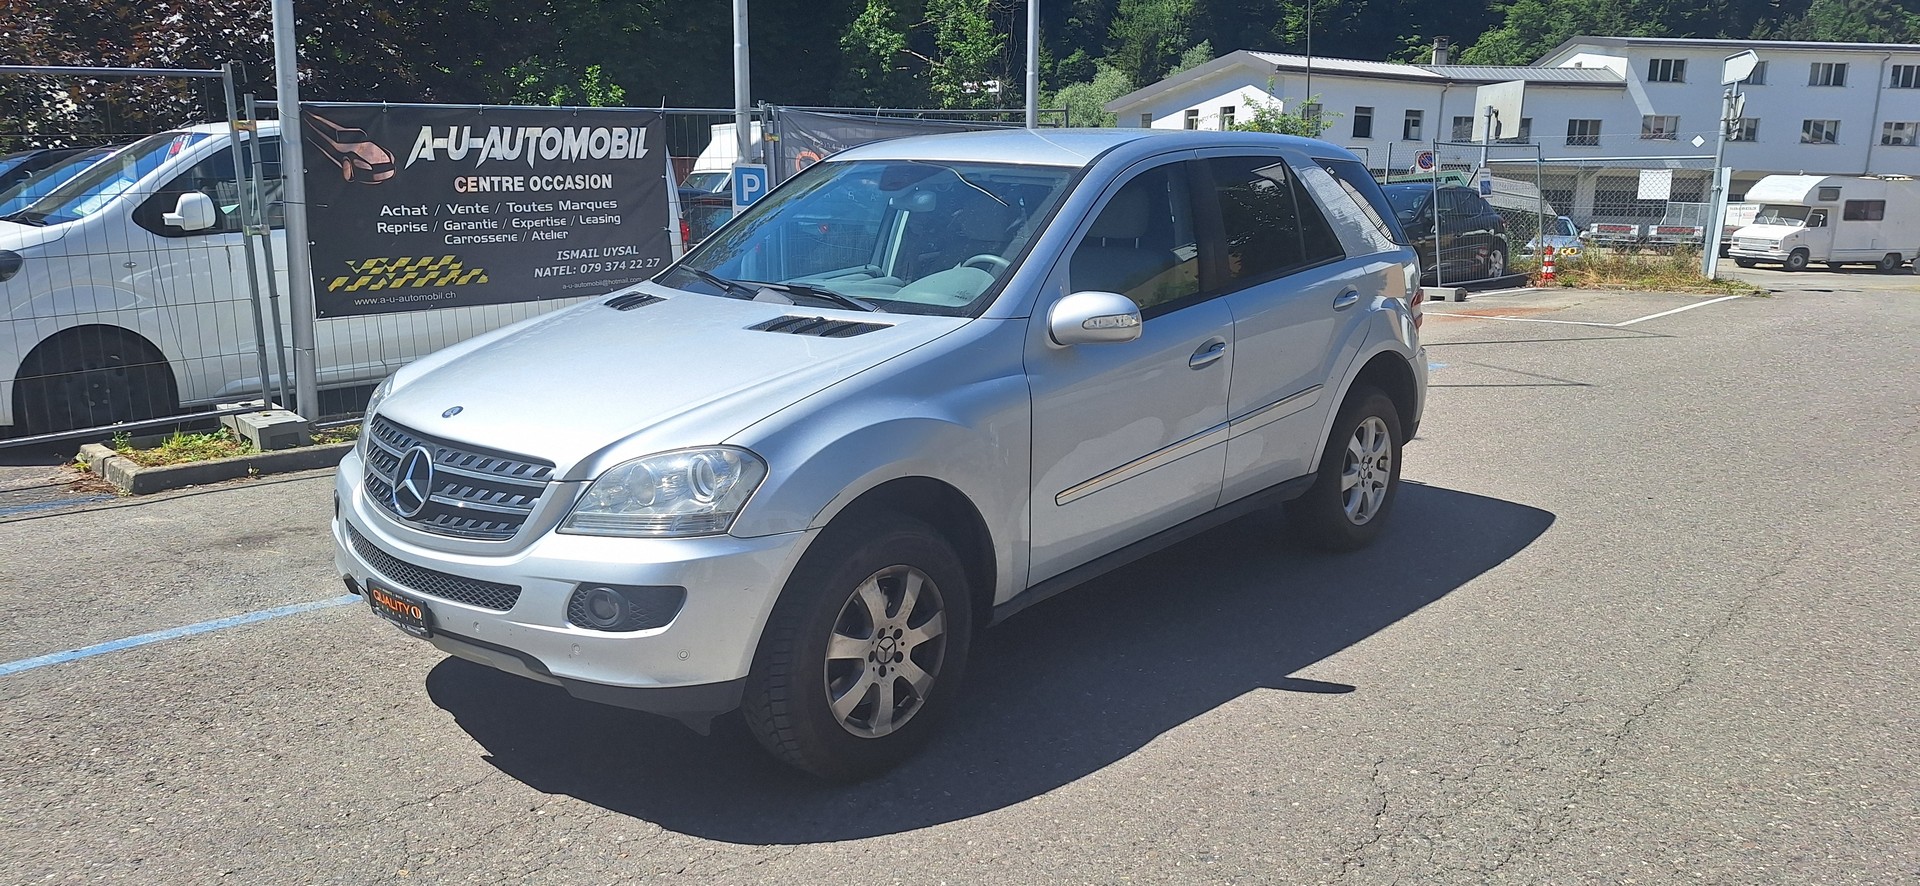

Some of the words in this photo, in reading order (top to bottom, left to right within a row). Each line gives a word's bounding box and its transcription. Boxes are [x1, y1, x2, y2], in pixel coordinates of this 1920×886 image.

[404, 125, 649, 170] A-U-AUTOMOBIL
[454, 176, 525, 193] CENTRE
[529, 174, 612, 191] OCCASION
[742, 174, 760, 201] P
[380, 204, 428, 217] Achat
[446, 203, 490, 215] Vente
[506, 202, 553, 213] Toutes
[558, 200, 618, 212] Marques
[377, 221, 428, 235] Reprise
[443, 219, 498, 231] Garantie
[511, 216, 567, 230] Expertise
[579, 213, 621, 225] Leasing
[444, 232, 518, 245] Carrosserie
[531, 230, 569, 241] Atelier
[556, 248, 600, 261] ISMAIL
[603, 245, 639, 257] UYSAL
[534, 264, 577, 278] NATEL:
[580, 262, 601, 274] 079
[604, 260, 627, 272] 374
[629, 259, 643, 269] 22
[646, 257, 660, 268] 27
[354, 290, 457, 306] www.a-u-automobil.ch
[373, 589, 410, 615] QUALITY
